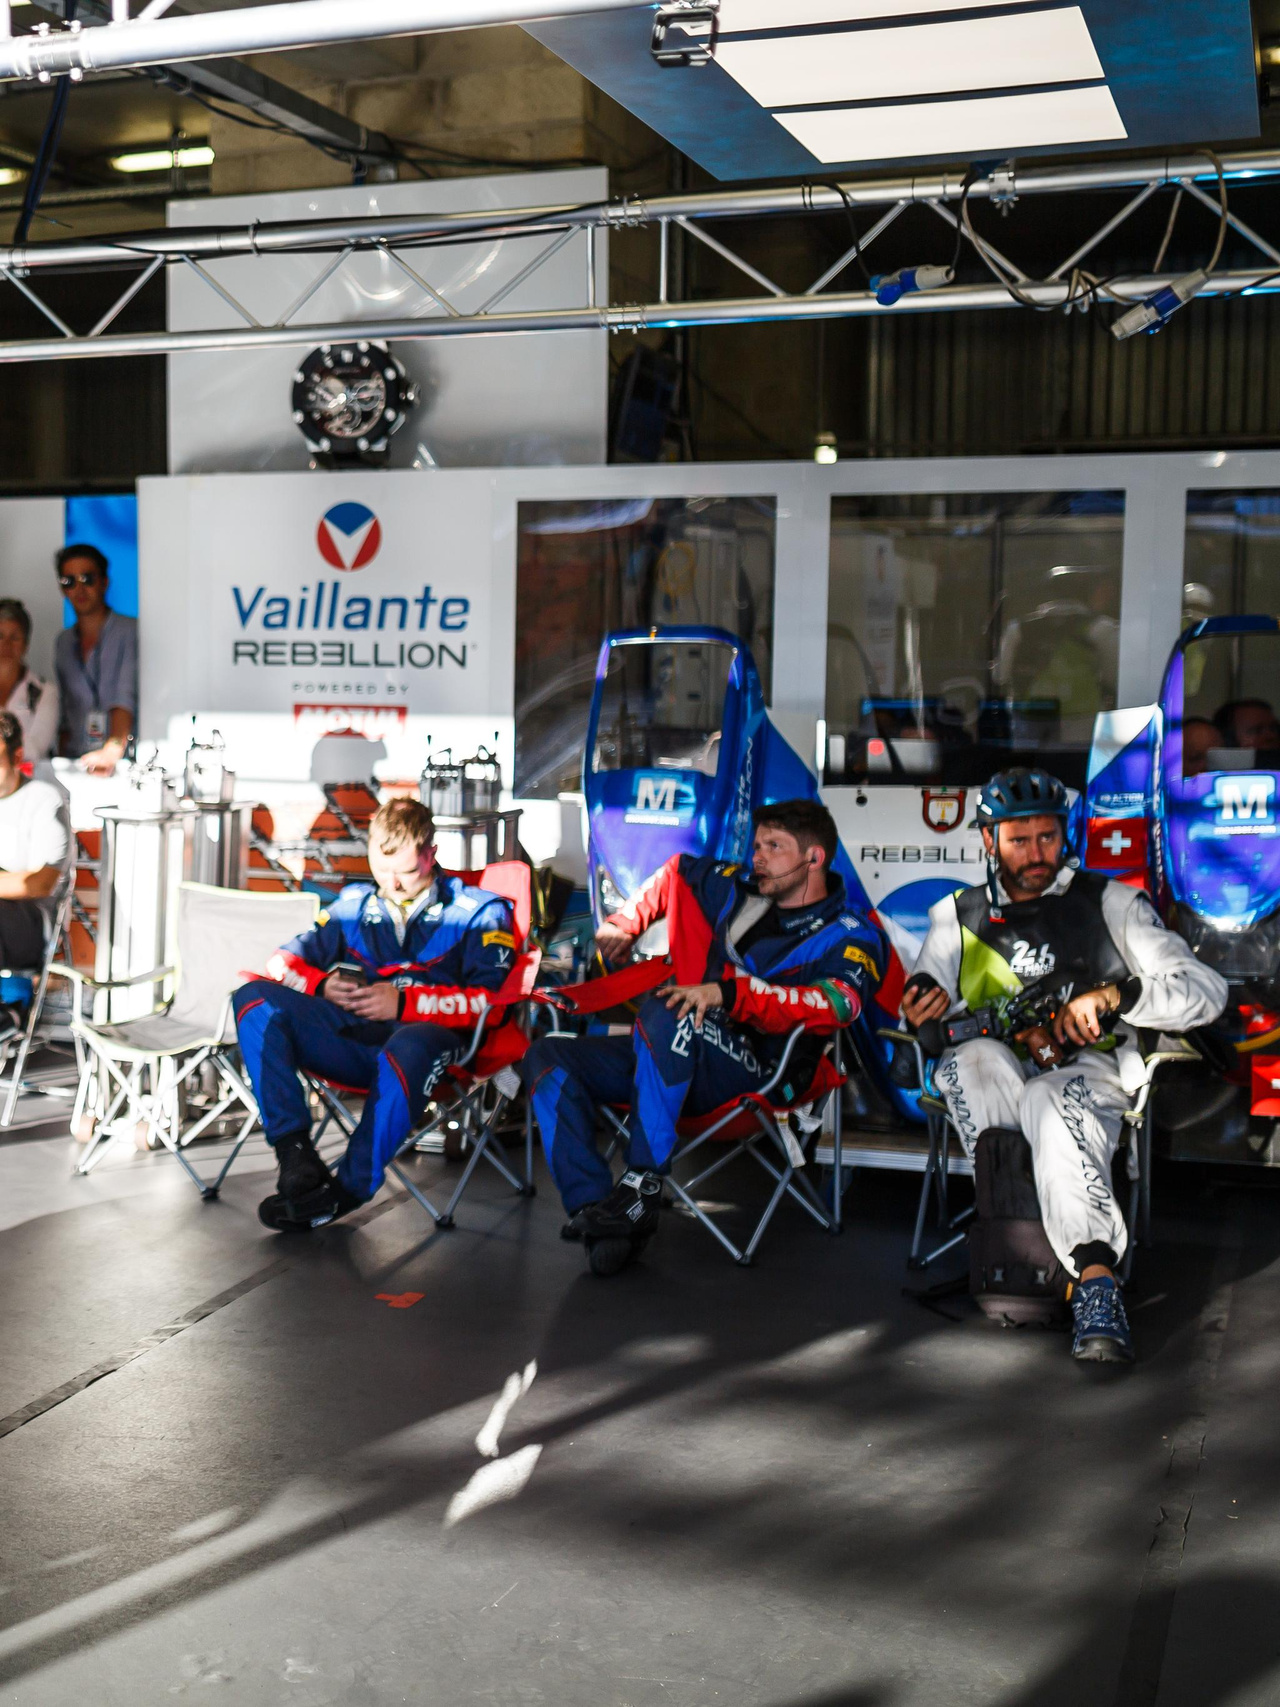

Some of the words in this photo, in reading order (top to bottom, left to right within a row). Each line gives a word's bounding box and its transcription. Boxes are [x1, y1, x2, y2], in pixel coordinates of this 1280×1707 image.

[232, 582, 470, 631] Vaillante
[233, 641, 467, 669] REBELLION
[292, 683, 377, 695] POWERED
[387, 684, 409, 695] BY
[636, 778, 677, 811] M
[1222, 784, 1267, 819] M
[861, 845, 990, 864] REBELLI
[417, 992, 489, 1015] MOTU
